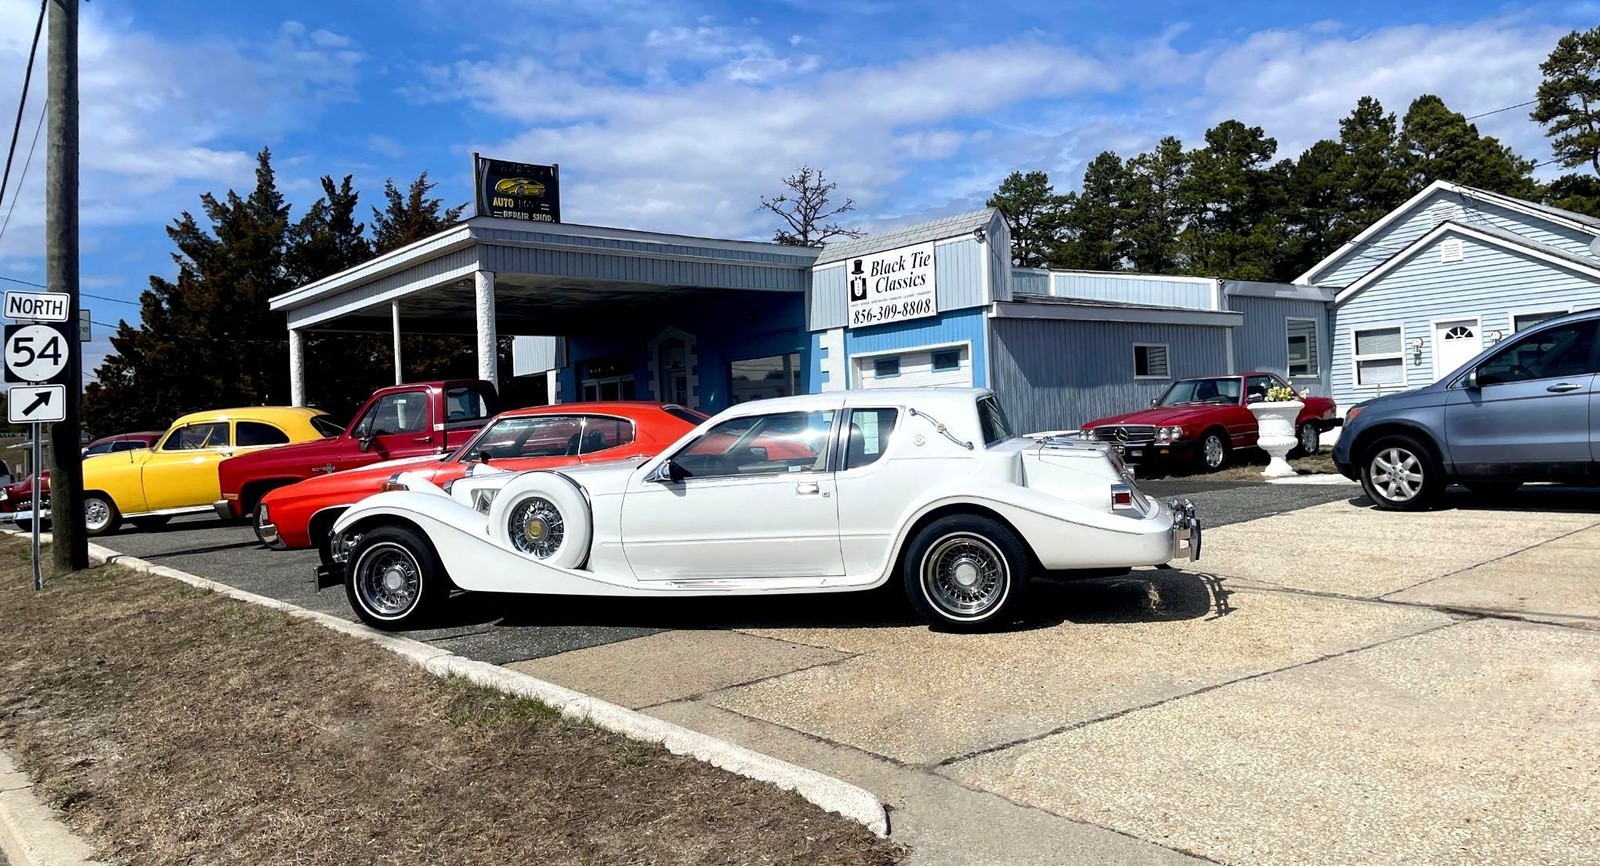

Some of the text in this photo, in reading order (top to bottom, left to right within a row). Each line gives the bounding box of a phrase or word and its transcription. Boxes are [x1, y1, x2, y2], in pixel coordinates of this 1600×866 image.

[493, 197, 514, 207] AUTO
[870, 251, 931, 277] Black Tie
[875, 271, 926, 294] Classics
[10, 296, 63, 316] NORTH
[853, 298, 931, 325] 856-309-8808
[13, 336, 62, 367] 54
